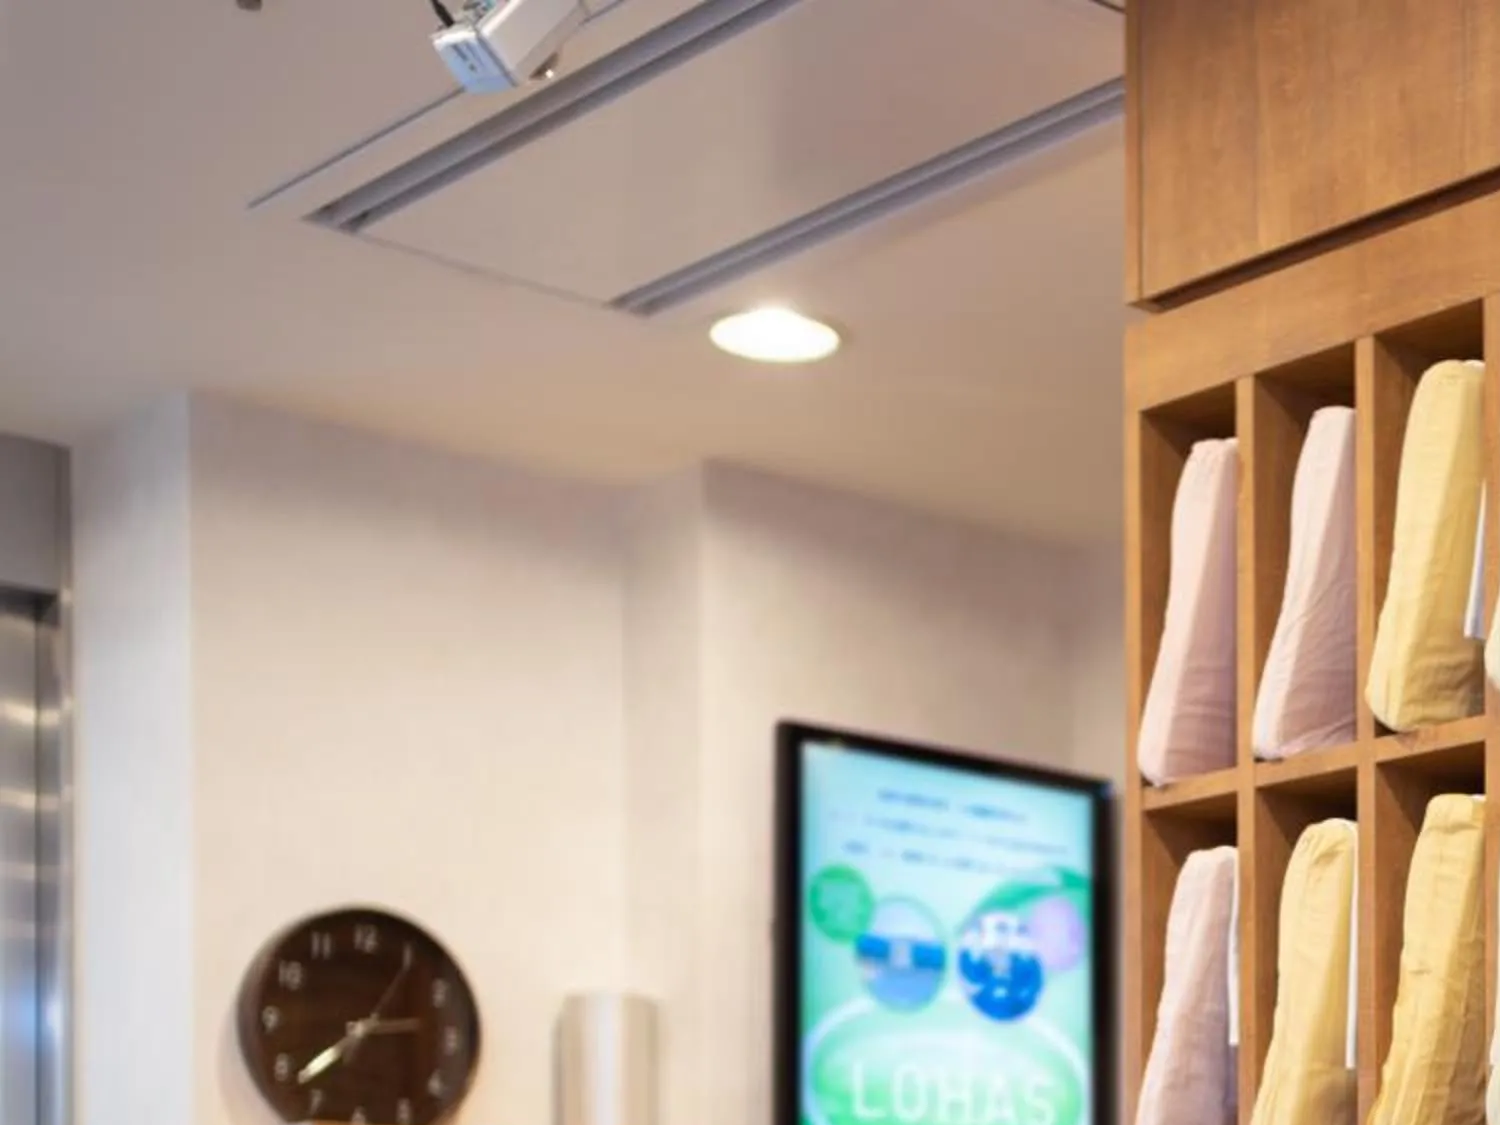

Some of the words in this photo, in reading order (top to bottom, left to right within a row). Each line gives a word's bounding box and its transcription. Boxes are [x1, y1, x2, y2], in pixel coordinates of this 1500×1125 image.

[311, 931, 332, 960] 11
[353, 923, 379, 954] 12
[278, 960, 303, 991] 10
[261, 1005, 281, 1034] 9
